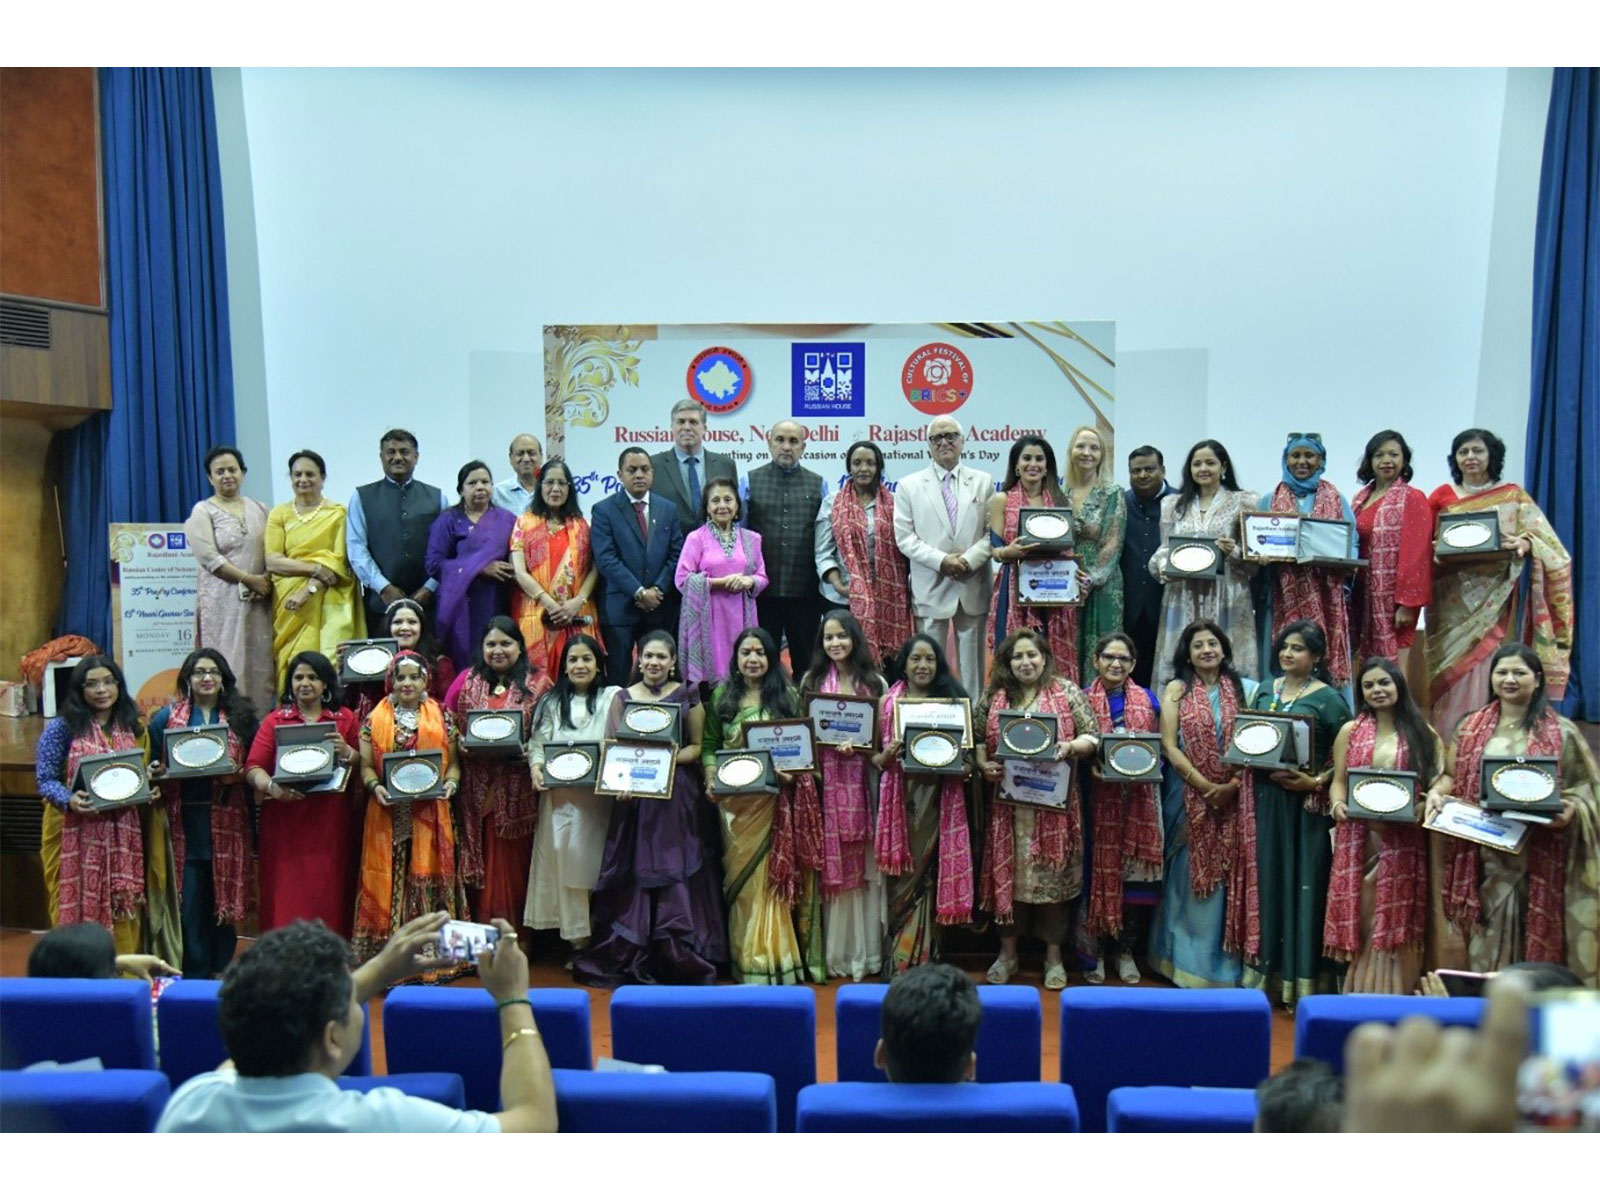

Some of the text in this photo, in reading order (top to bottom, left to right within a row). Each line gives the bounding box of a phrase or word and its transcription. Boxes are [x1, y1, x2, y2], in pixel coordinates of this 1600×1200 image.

[906, 346, 970, 384] CULTURAL FESTIVAL OF
[702, 428, 745, 444] ouse,
[748, 425, 772, 442] Ne
[755, 450, 770, 460] on
[978, 449, 1001, 463] Day
[177, 628, 193, 641] 16
